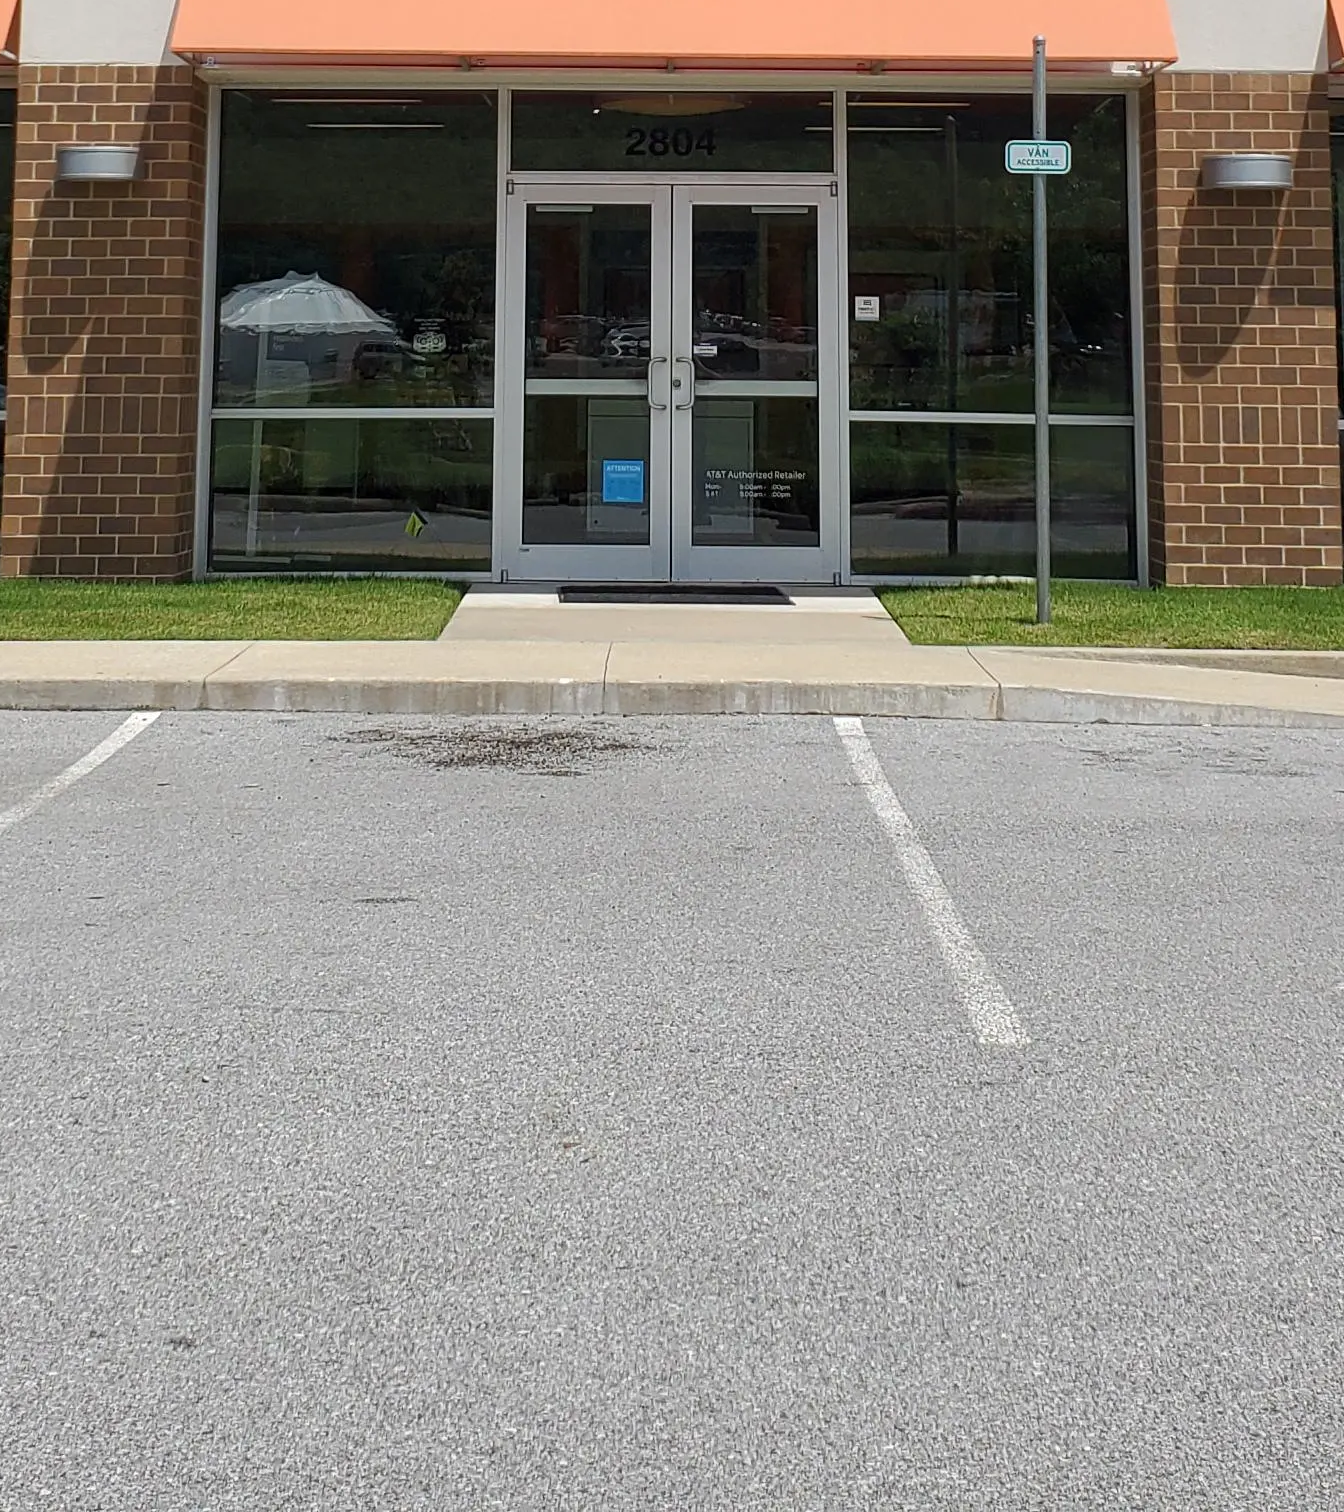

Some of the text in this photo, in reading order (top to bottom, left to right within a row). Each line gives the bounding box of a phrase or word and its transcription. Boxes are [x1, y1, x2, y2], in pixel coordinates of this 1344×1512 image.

[625, 127, 716, 156] 2804
[1027, 148, 1049, 157] VAN
[1016, 158, 1060, 166] ACCESSIBLE
[606, 464, 641, 472] ATTENTION
[727, 469, 773, 480] Authorized
[774, 470, 806, 480] Retailer
